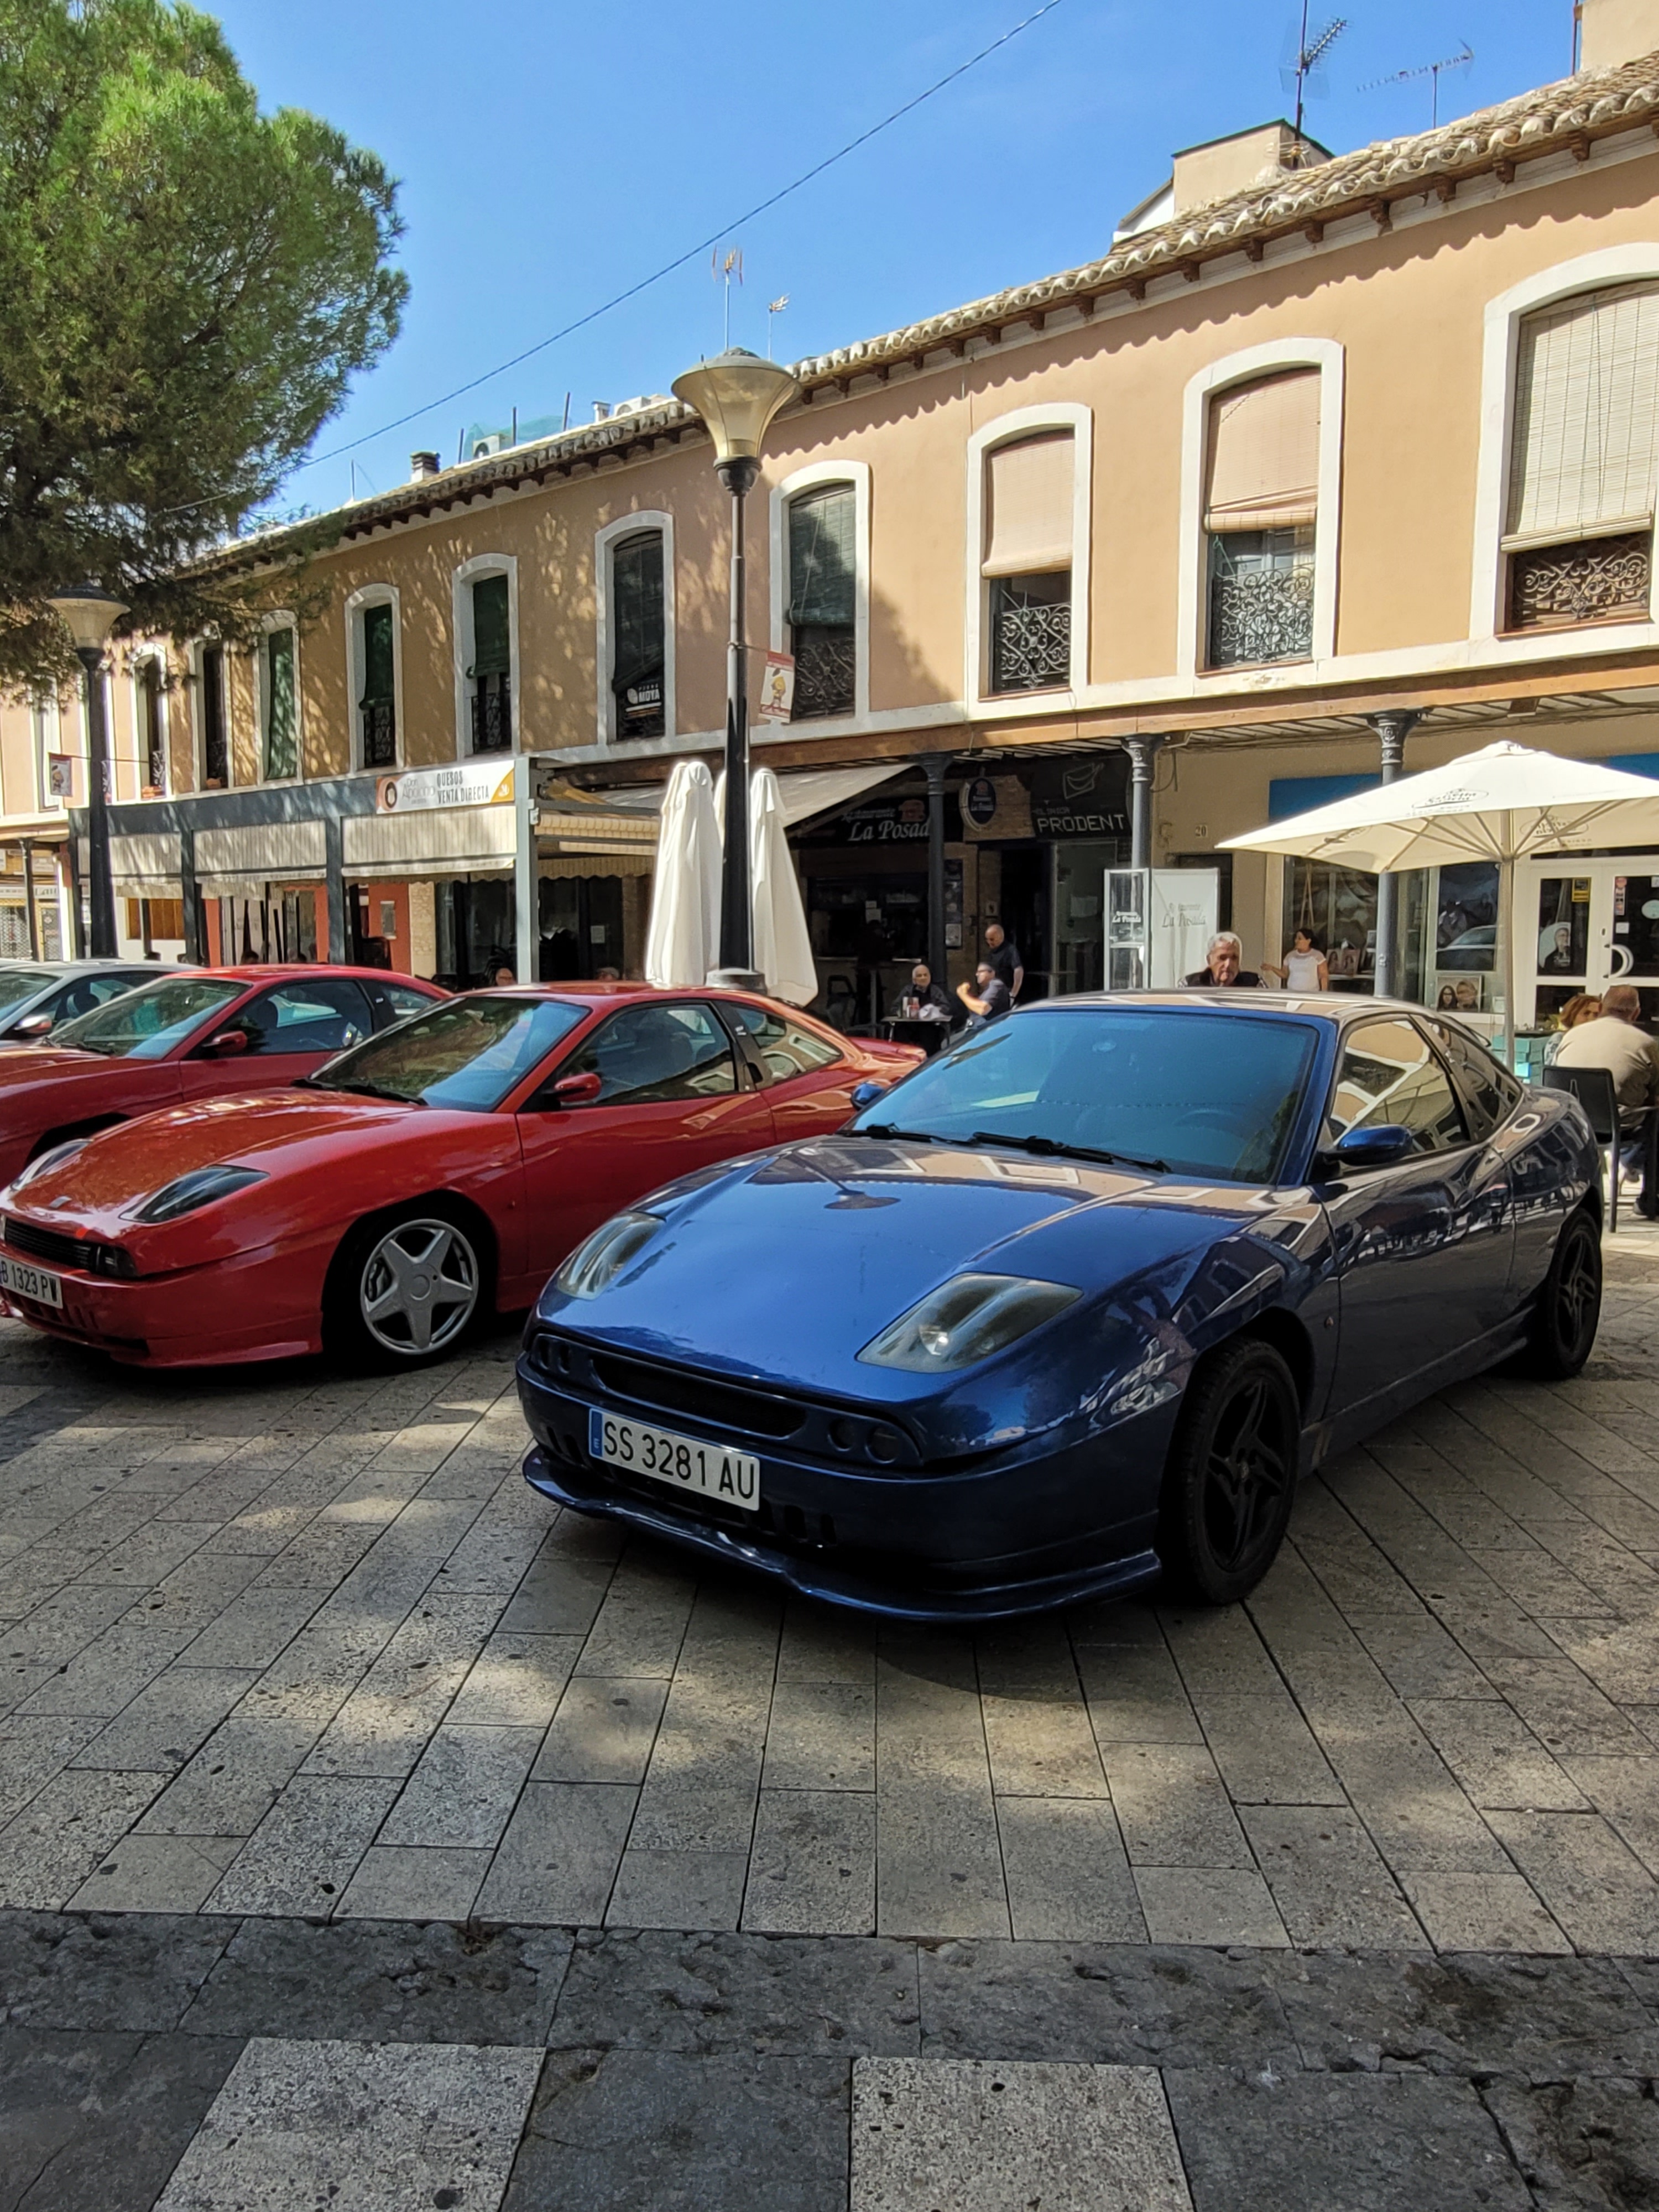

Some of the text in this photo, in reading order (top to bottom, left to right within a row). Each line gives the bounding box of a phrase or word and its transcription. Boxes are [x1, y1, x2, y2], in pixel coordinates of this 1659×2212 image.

[639, 688, 660, 702] MOYA
[436, 770, 463, 788] QUESOS
[437, 785, 489, 804] VENTA DIRECTA
[848, 817, 931, 841] La Posad
[1037, 814, 1125, 833] PRODENT
[1195, 826, 1207, 837] 20
[12, 1264, 38, 1295] 1323
[604, 1421, 634, 1462] SS
[641, 1433, 706, 1487] 3281
[718, 1456, 754, 1500] AU
